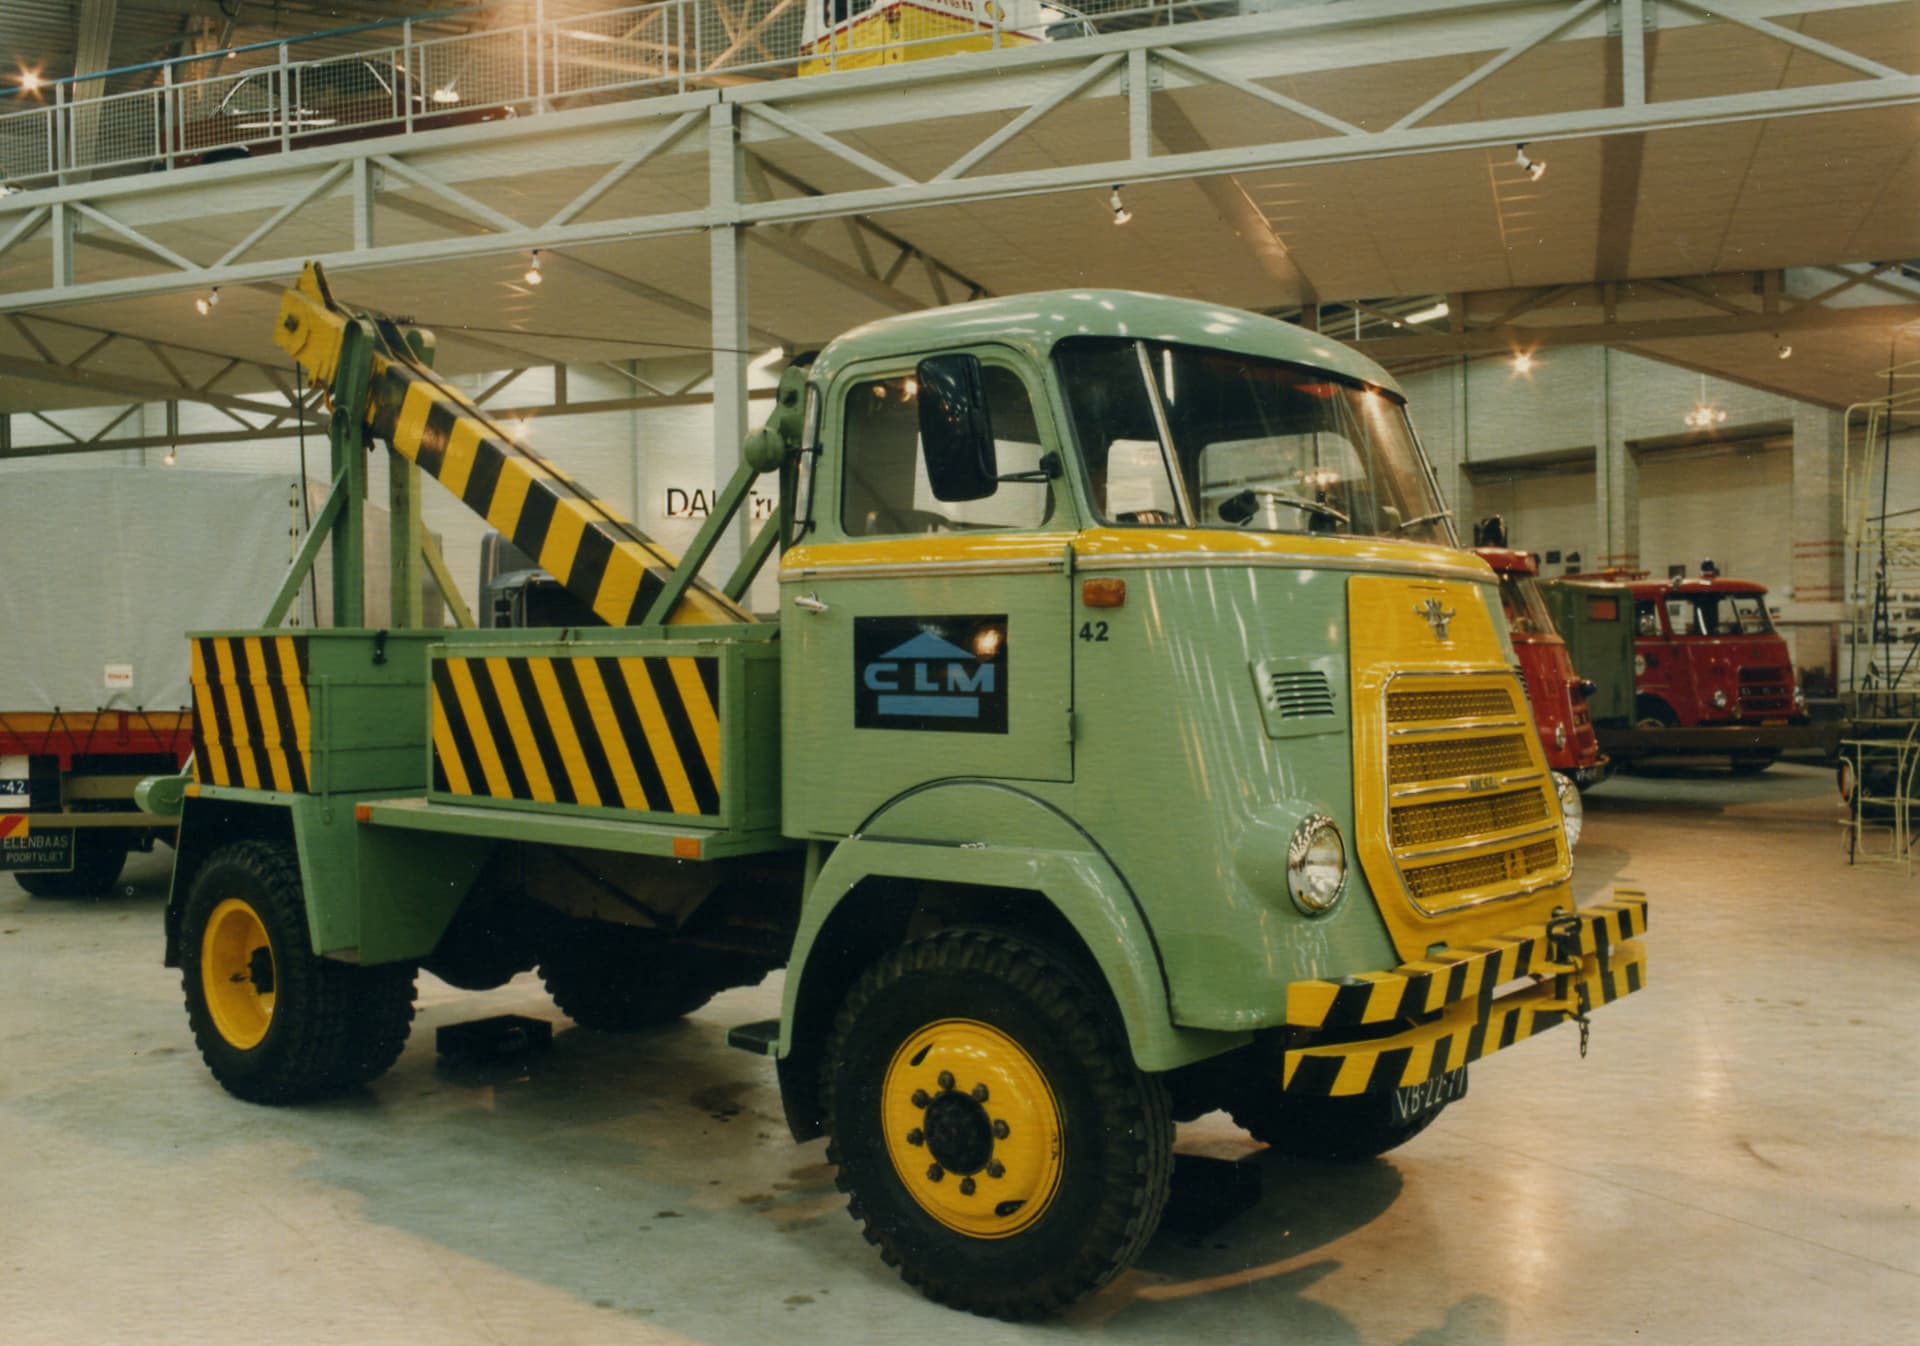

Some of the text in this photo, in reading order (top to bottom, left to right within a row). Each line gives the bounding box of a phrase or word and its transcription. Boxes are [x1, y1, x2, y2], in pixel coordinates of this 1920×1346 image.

[667, 488, 716, 517] DA
[1079, 621, 1109, 642] 42
[863, 662, 995, 693] CLM
